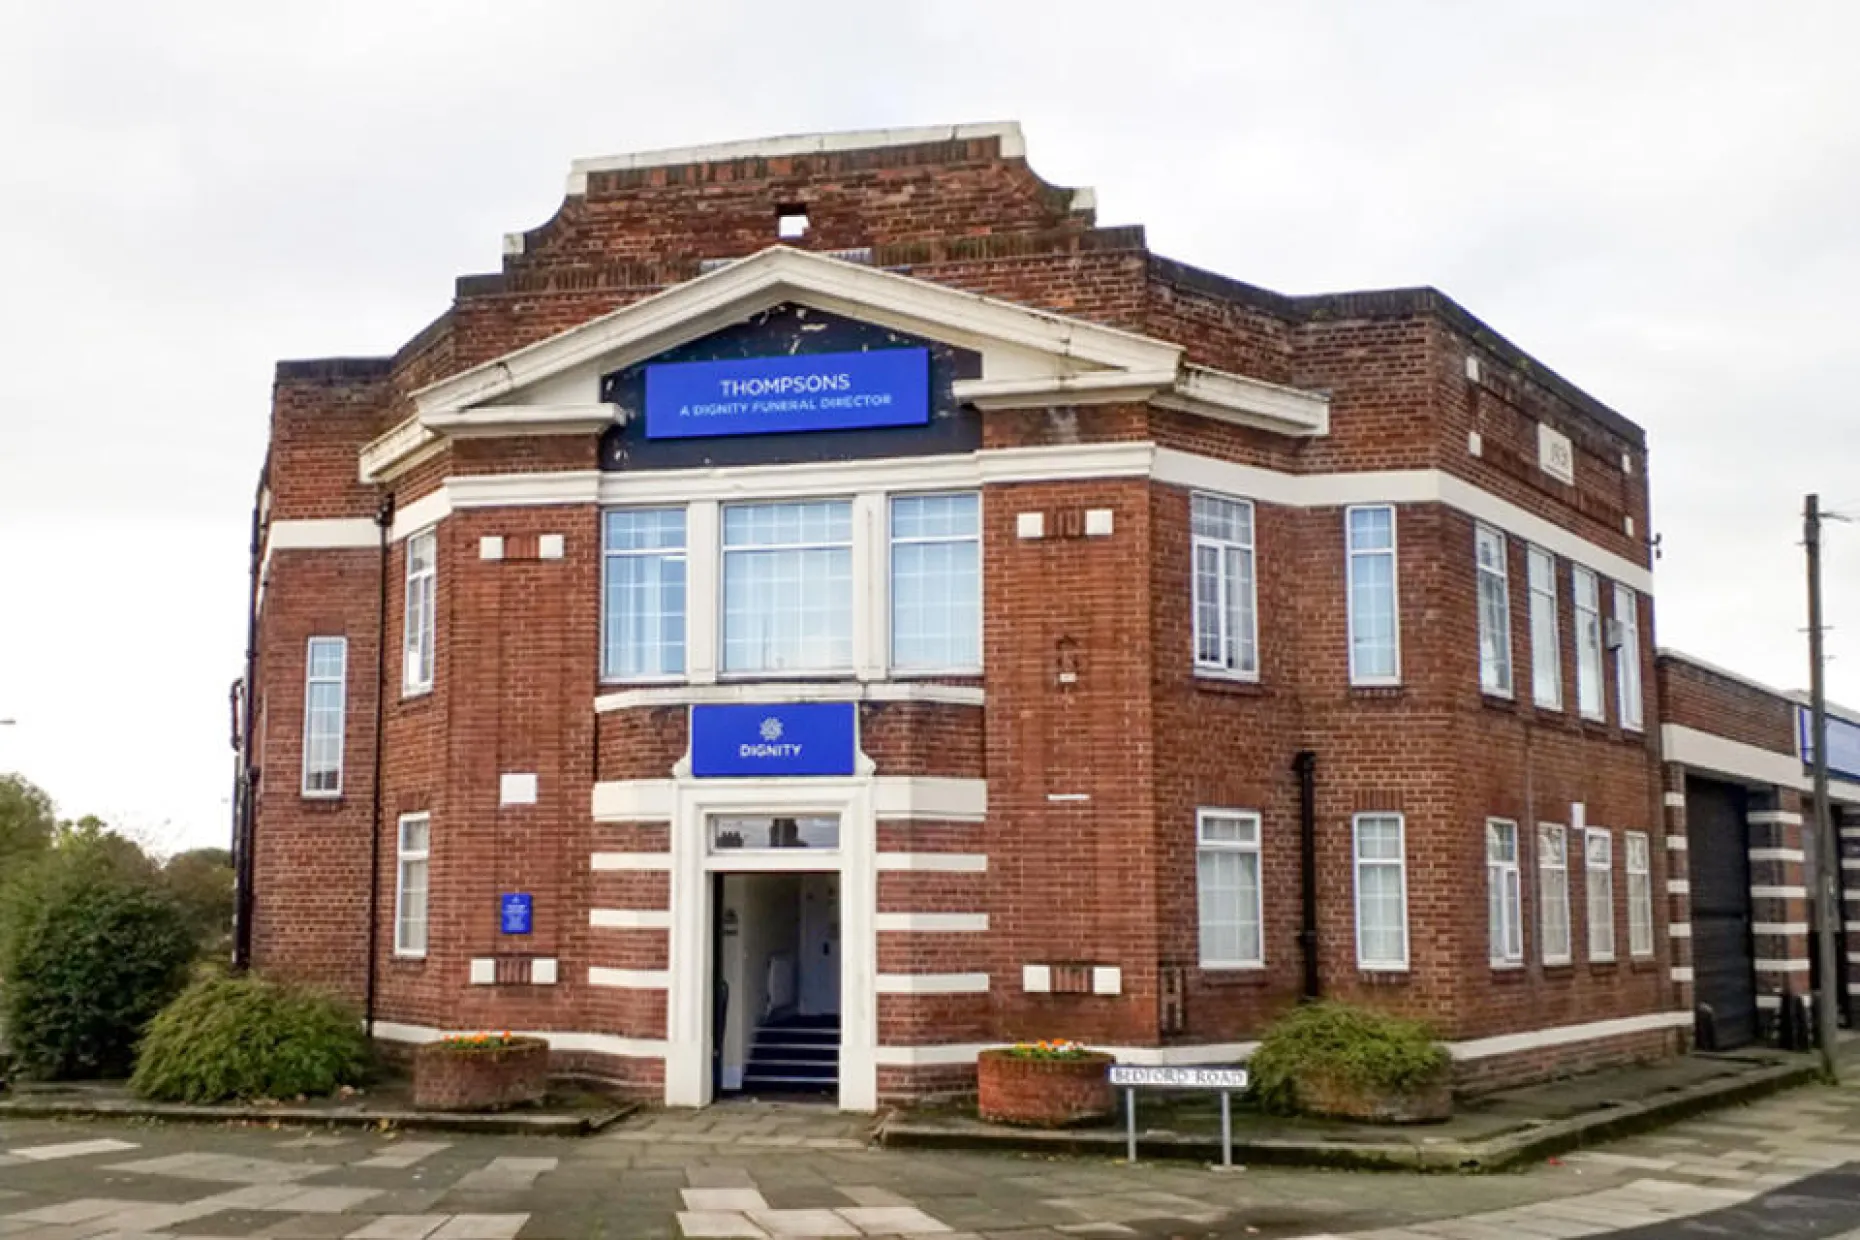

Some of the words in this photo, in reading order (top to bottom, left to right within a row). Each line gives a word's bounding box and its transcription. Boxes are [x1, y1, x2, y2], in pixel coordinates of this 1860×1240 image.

[719, 373, 851, 398] THOMPSONS
[680, 405, 690, 417] A
[693, 402, 749, 417] DIGNITY
[753, 398, 816, 413] FUNERAL
[821, 394, 892, 410] DIRECTOR
[739, 743, 803, 758] DIGNITY
[1114, 1067, 1187, 1082] BEDFORD
[1197, 1069, 1244, 1084] ROAD
